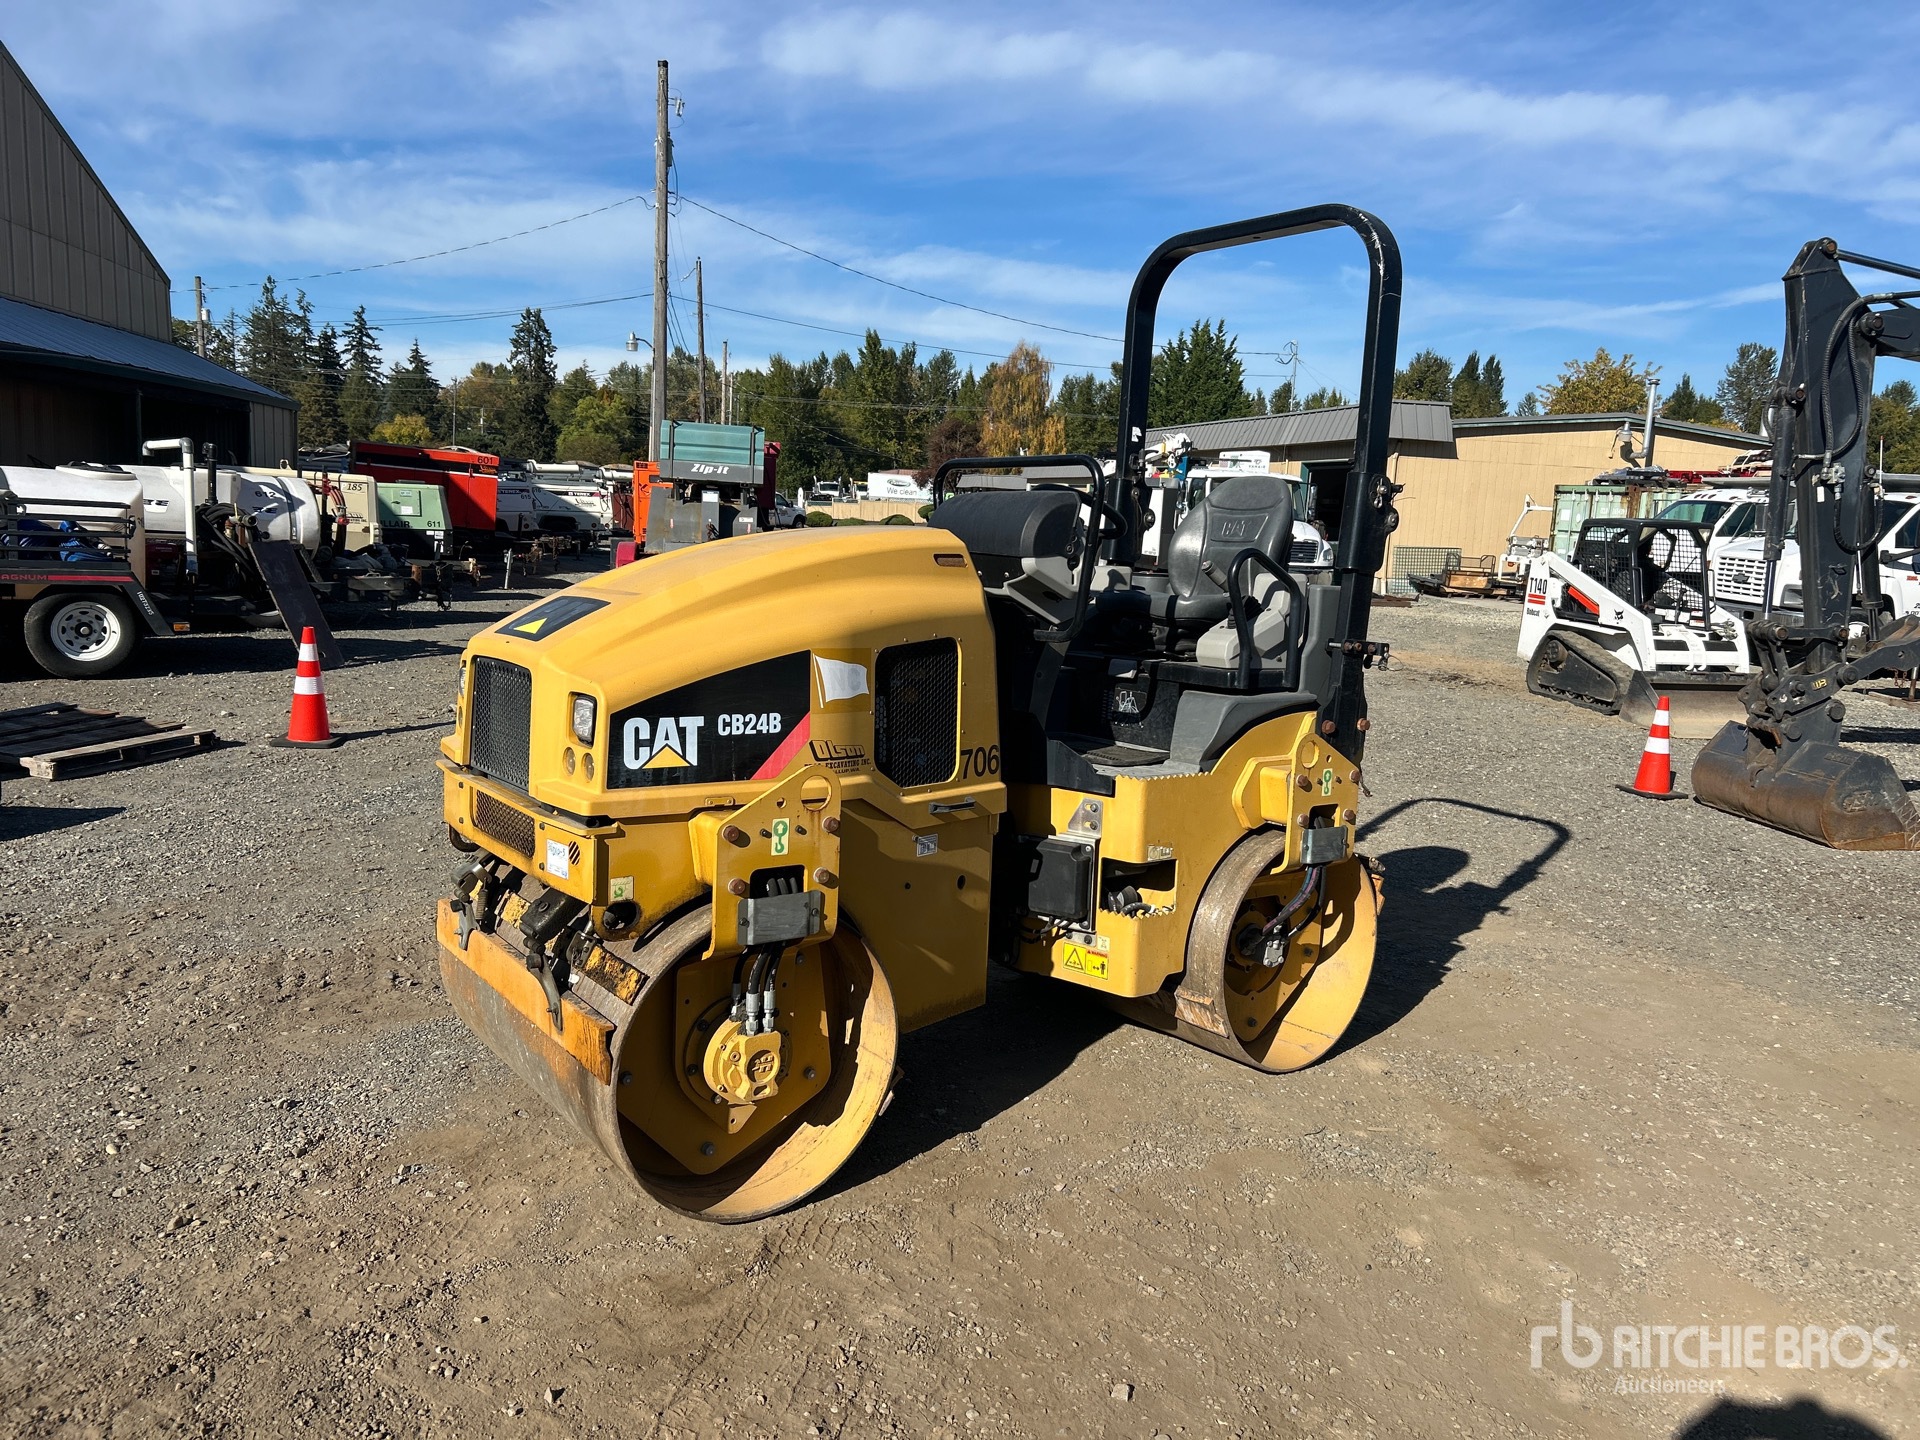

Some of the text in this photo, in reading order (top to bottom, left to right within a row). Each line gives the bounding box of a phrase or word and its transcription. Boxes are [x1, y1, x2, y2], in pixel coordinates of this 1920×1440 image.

[477, 456, 494, 465] 601
[254, 490, 276, 499] 612
[887, 487, 898, 495] We
[899, 488, 918, 496] clean
[427, 520, 441, 528] 611
[0, 573, 48, 581] AGNUM
[1529, 577, 1548, 595] T140
[623, 712, 782, 770] CAT CB24B
[809, 739, 866, 763] Olson
[960, 744, 1000, 780] 706
